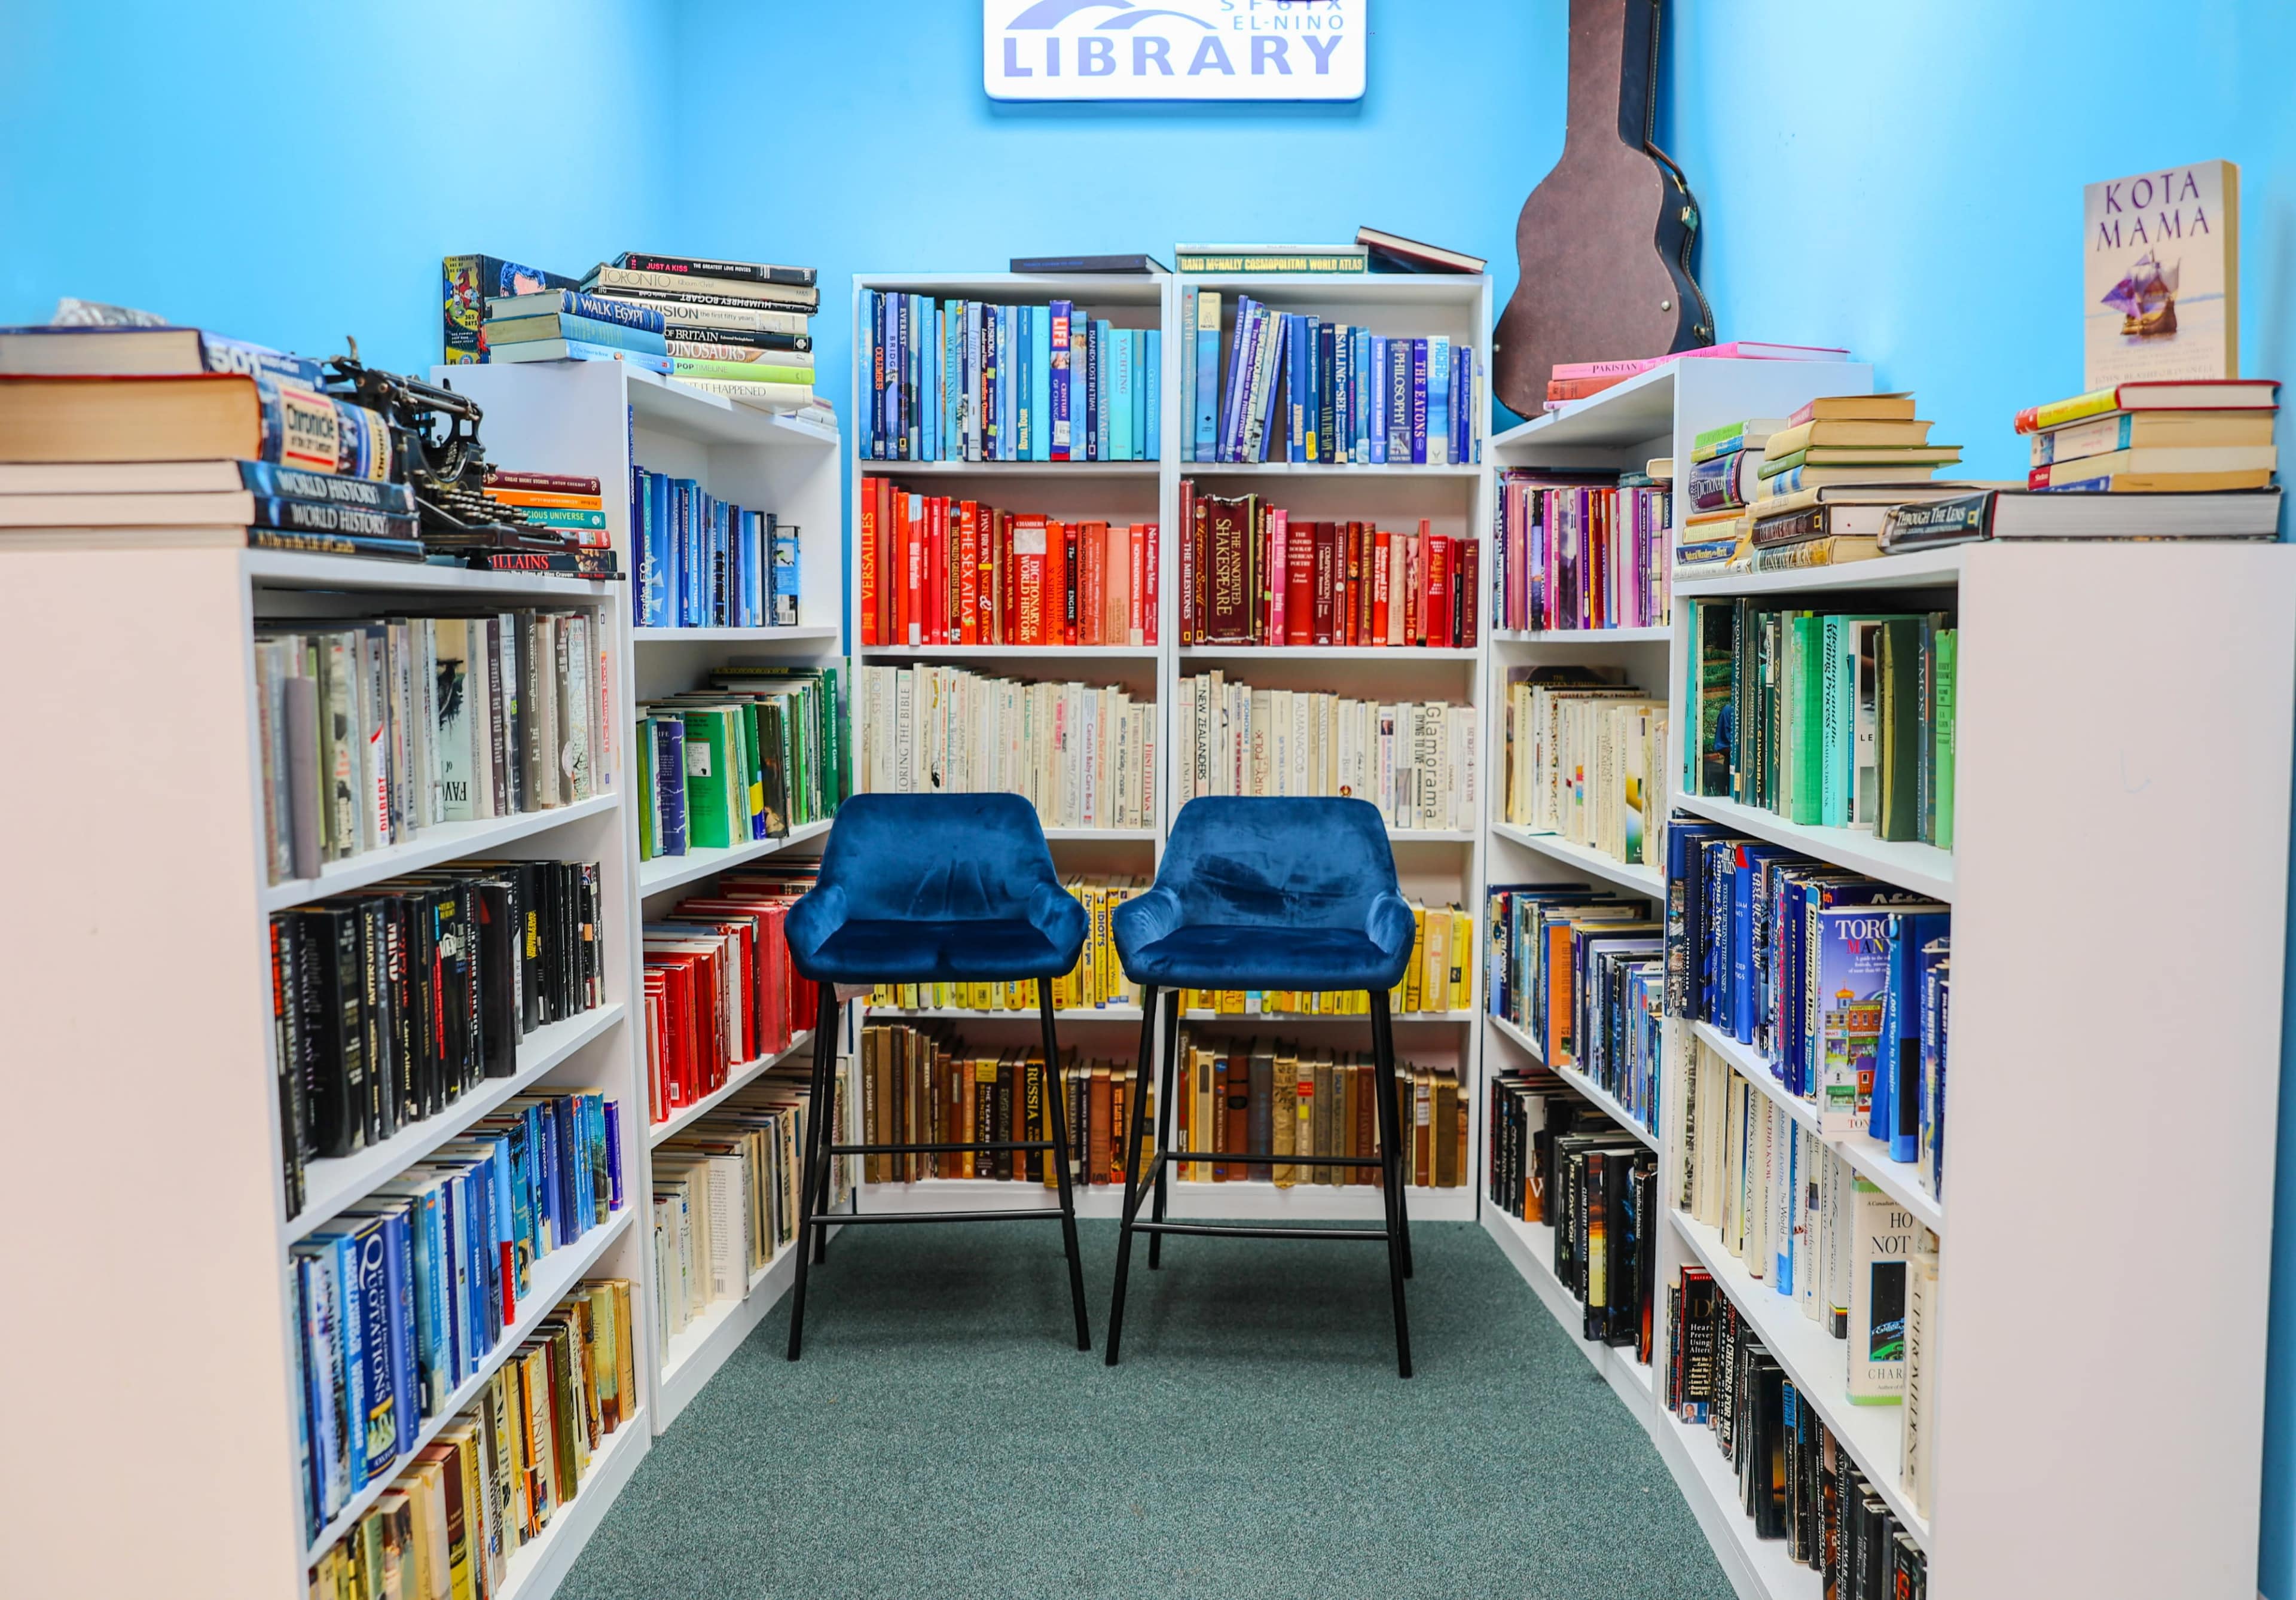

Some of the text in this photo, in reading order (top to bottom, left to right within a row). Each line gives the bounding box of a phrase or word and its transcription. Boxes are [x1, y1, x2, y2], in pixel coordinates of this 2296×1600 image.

[1233, 15, 1344, 30] EL-NINO
[1004, 35, 1343, 77] LIBRARY
[2106, 170, 2200, 215] KOTA
[2096, 206, 2210, 252] MAMA
[602, 268, 670, 288] TORONTO
[646, 262, 665, 271] JUST
[671, 263, 688, 272] KISS
[1244, 258, 1363, 271] COSMOPOLITAN WORLD ATLAS
[582, 297, 645, 324] WALK EGYPT
[680, 293, 771, 309] HUMPHREY BOGART
[1185, 303, 1194, 341] EARTH
[667, 342, 746, 361] DINOSAURS
[676, 329, 718, 341] BRITAIN
[987, 316, 996, 358] MUSKOKA
[1054, 317, 1067, 347] LIFE
[1234, 311, 1244, 350] STRATFORD
[695, 364, 728, 374] TIMELINE
[875, 346, 884, 390] COLUMBUS
[946, 335, 954, 404] WORLD TENNIS
[1119, 338, 1128, 395] YACHTING
[1252, 317, 1268, 393] THE SPLENDOUR OF
[1336, 334, 1347, 413] SAILING SEE
[1434, 341, 1448, 378] PACIFIC
[1592, 362, 1637, 374] PAKISTAN
[712, 384, 766, 397] HAPPENED
[1052, 378, 1059, 389] OF
[1088, 382, 1096, 392] IN
[1393, 352, 1406, 425] PHILOSOPHY
[1414, 360, 1427, 438] THE EATONS
[286, 402, 335, 440] Chronicle
[1099, 398, 1108, 442] VOYAGE
[1375, 409, 1384, 437] MARKET
[276, 469, 377, 504] WORLD HISTORY
[291, 503, 386, 535] WORLD HISTORY
[549, 512, 585, 521] UNIVERSE
[1895, 506, 1967, 527] THROUGH THE LENS
[862, 512, 874, 600] VERSAILLES
[981, 514, 989, 564] DAN BROWN
[951, 526, 960, 618] THE WORLD'S GREATEST BUILDINGS
[961, 521, 975, 624] THE SEX ATLAS
[1146, 527, 1156, 595] No Matter
[1183, 542, 1192, 619] THE MILESTONES
[1215, 518, 1232, 616] SHAKESPEARE
[1231, 530, 1241, 605] THE ANNOTATED
[1020, 555, 1031, 643] WORLD HISTORY
[1030, 560, 1040, 625] DICTIONARY
[529, 636, 538, 712] Somerset Maugham
[872, 671, 881, 714] PEOPLES
[899, 688, 909, 719] BIBLE
[899, 723, 909, 743] THE
[1197, 689, 1207, 780] NEW ZEALANDERS
[1415, 714, 1425, 737] DYING
[1083, 722, 1094, 811] Canada's Baby Care Book
[1144, 743, 1154, 768] FIRST
[1415, 749, 1425, 764] LIVE
[1425, 706, 1442, 819] Glamorama
[377, 777, 388, 832] DILBERT
[1715, 851, 1723, 948] Famous Myths
[1754, 902, 1761, 917] OF
[364, 912, 377, 1006] SOLUTION SELLING
[387, 923, 399, 983] MIND
[1808, 981, 1815, 993] of
[1890, 1048, 1895, 1058] to
[866, 1089, 874, 1112] SHARK
[1027, 1067, 1039, 1120] RUSSIA
[1779, 1205, 1788, 1234] World
[1871, 1235, 1911, 1254] NOT
[359, 1233, 386, 1403] QUOTATIONS
[1723, 1334, 1734, 1440] 3 CHEERS FOR ME
[533, 1406, 546, 1479] CHINA
